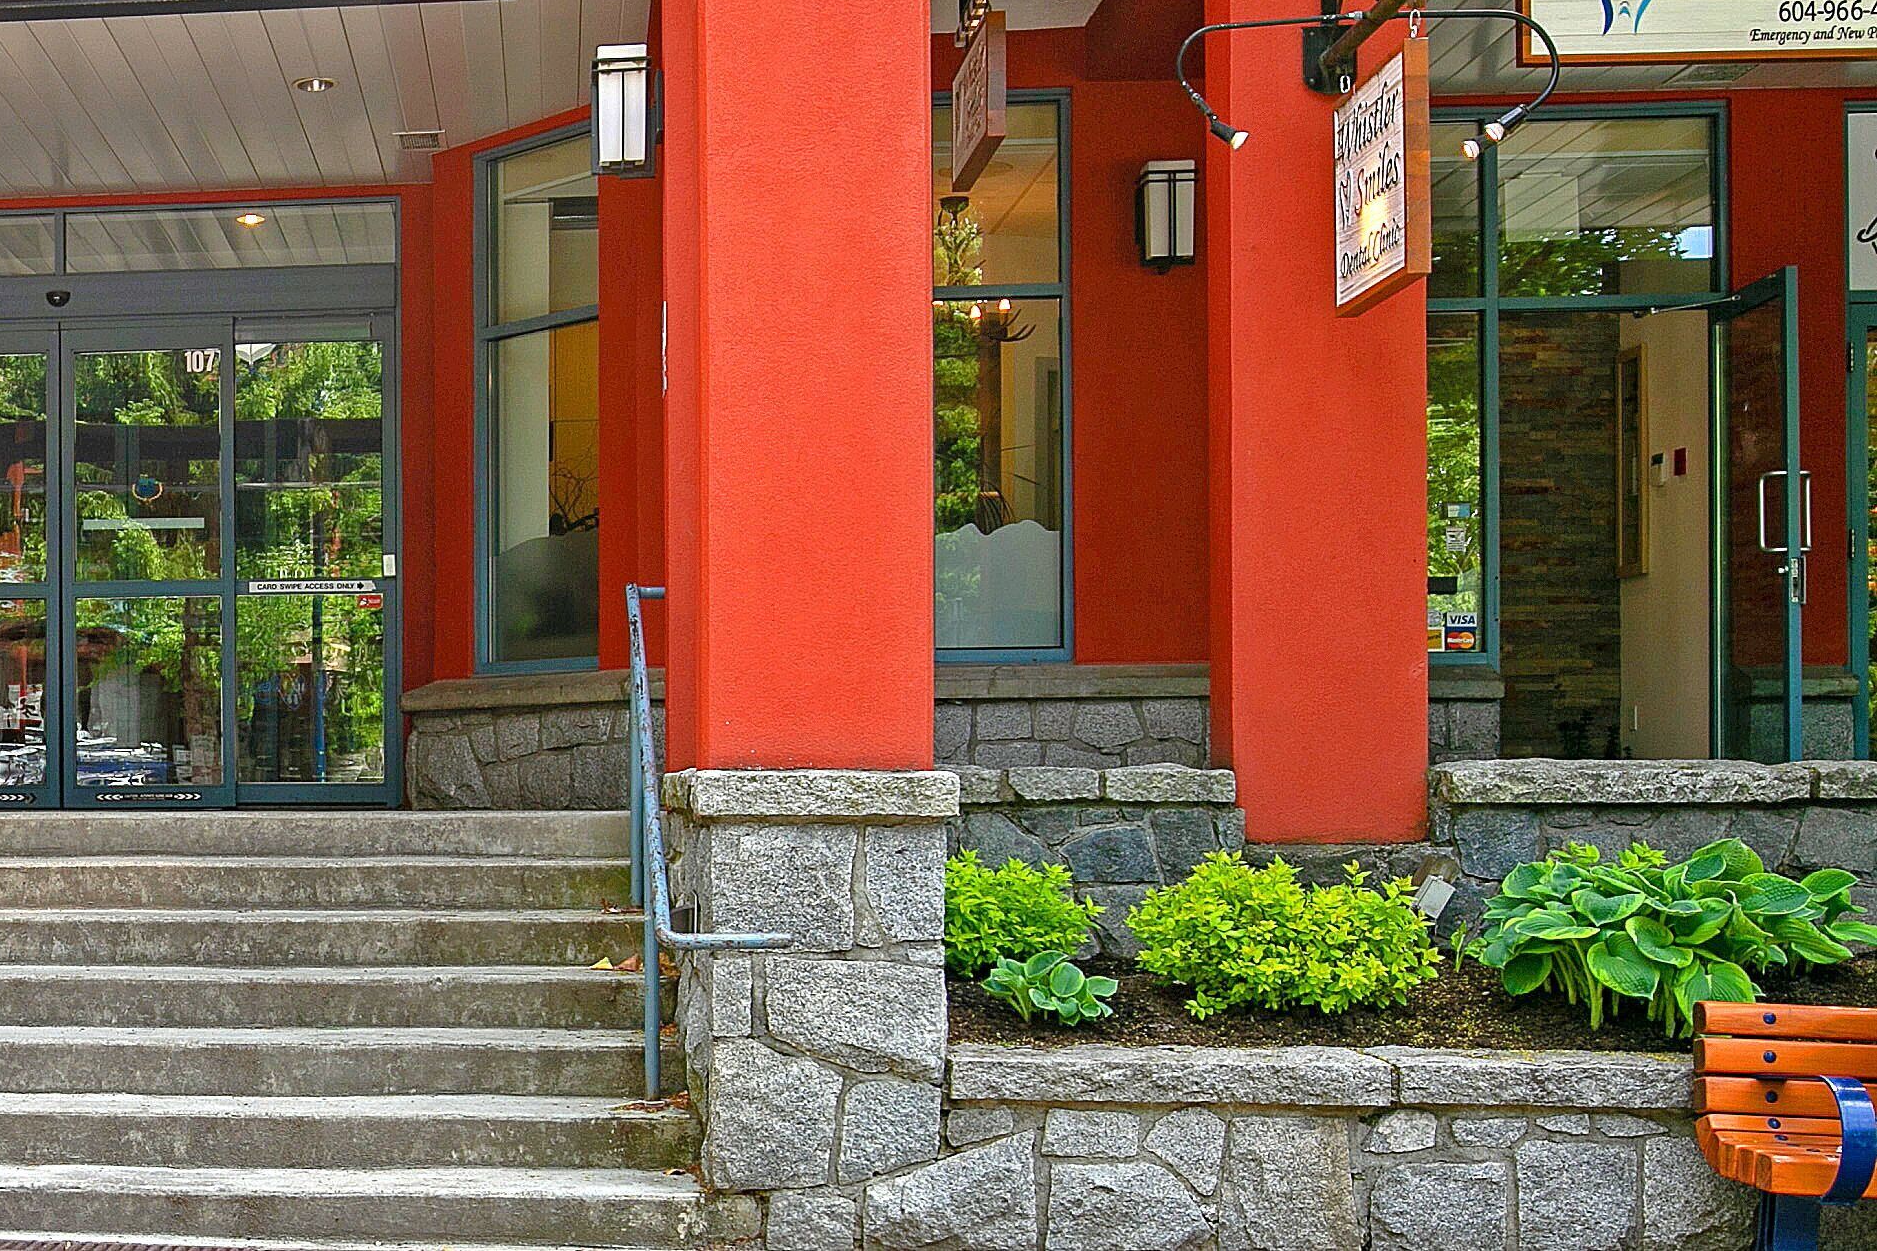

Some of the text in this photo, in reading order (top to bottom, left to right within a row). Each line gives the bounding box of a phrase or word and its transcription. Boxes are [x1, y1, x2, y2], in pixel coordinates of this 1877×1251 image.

[1750, 25, 1877, 45] Emergency and New P
[1337, 80, 1400, 167] Whistler
[1355, 140, 1401, 215] Smiles
[1340, 218, 1400, 278] Dental Clinic
[184, 350, 215, 373] 107
[257, 582, 355, 591] CARD SWIPE ACCESS ONLY
[1450, 615, 1475, 625] VISA
